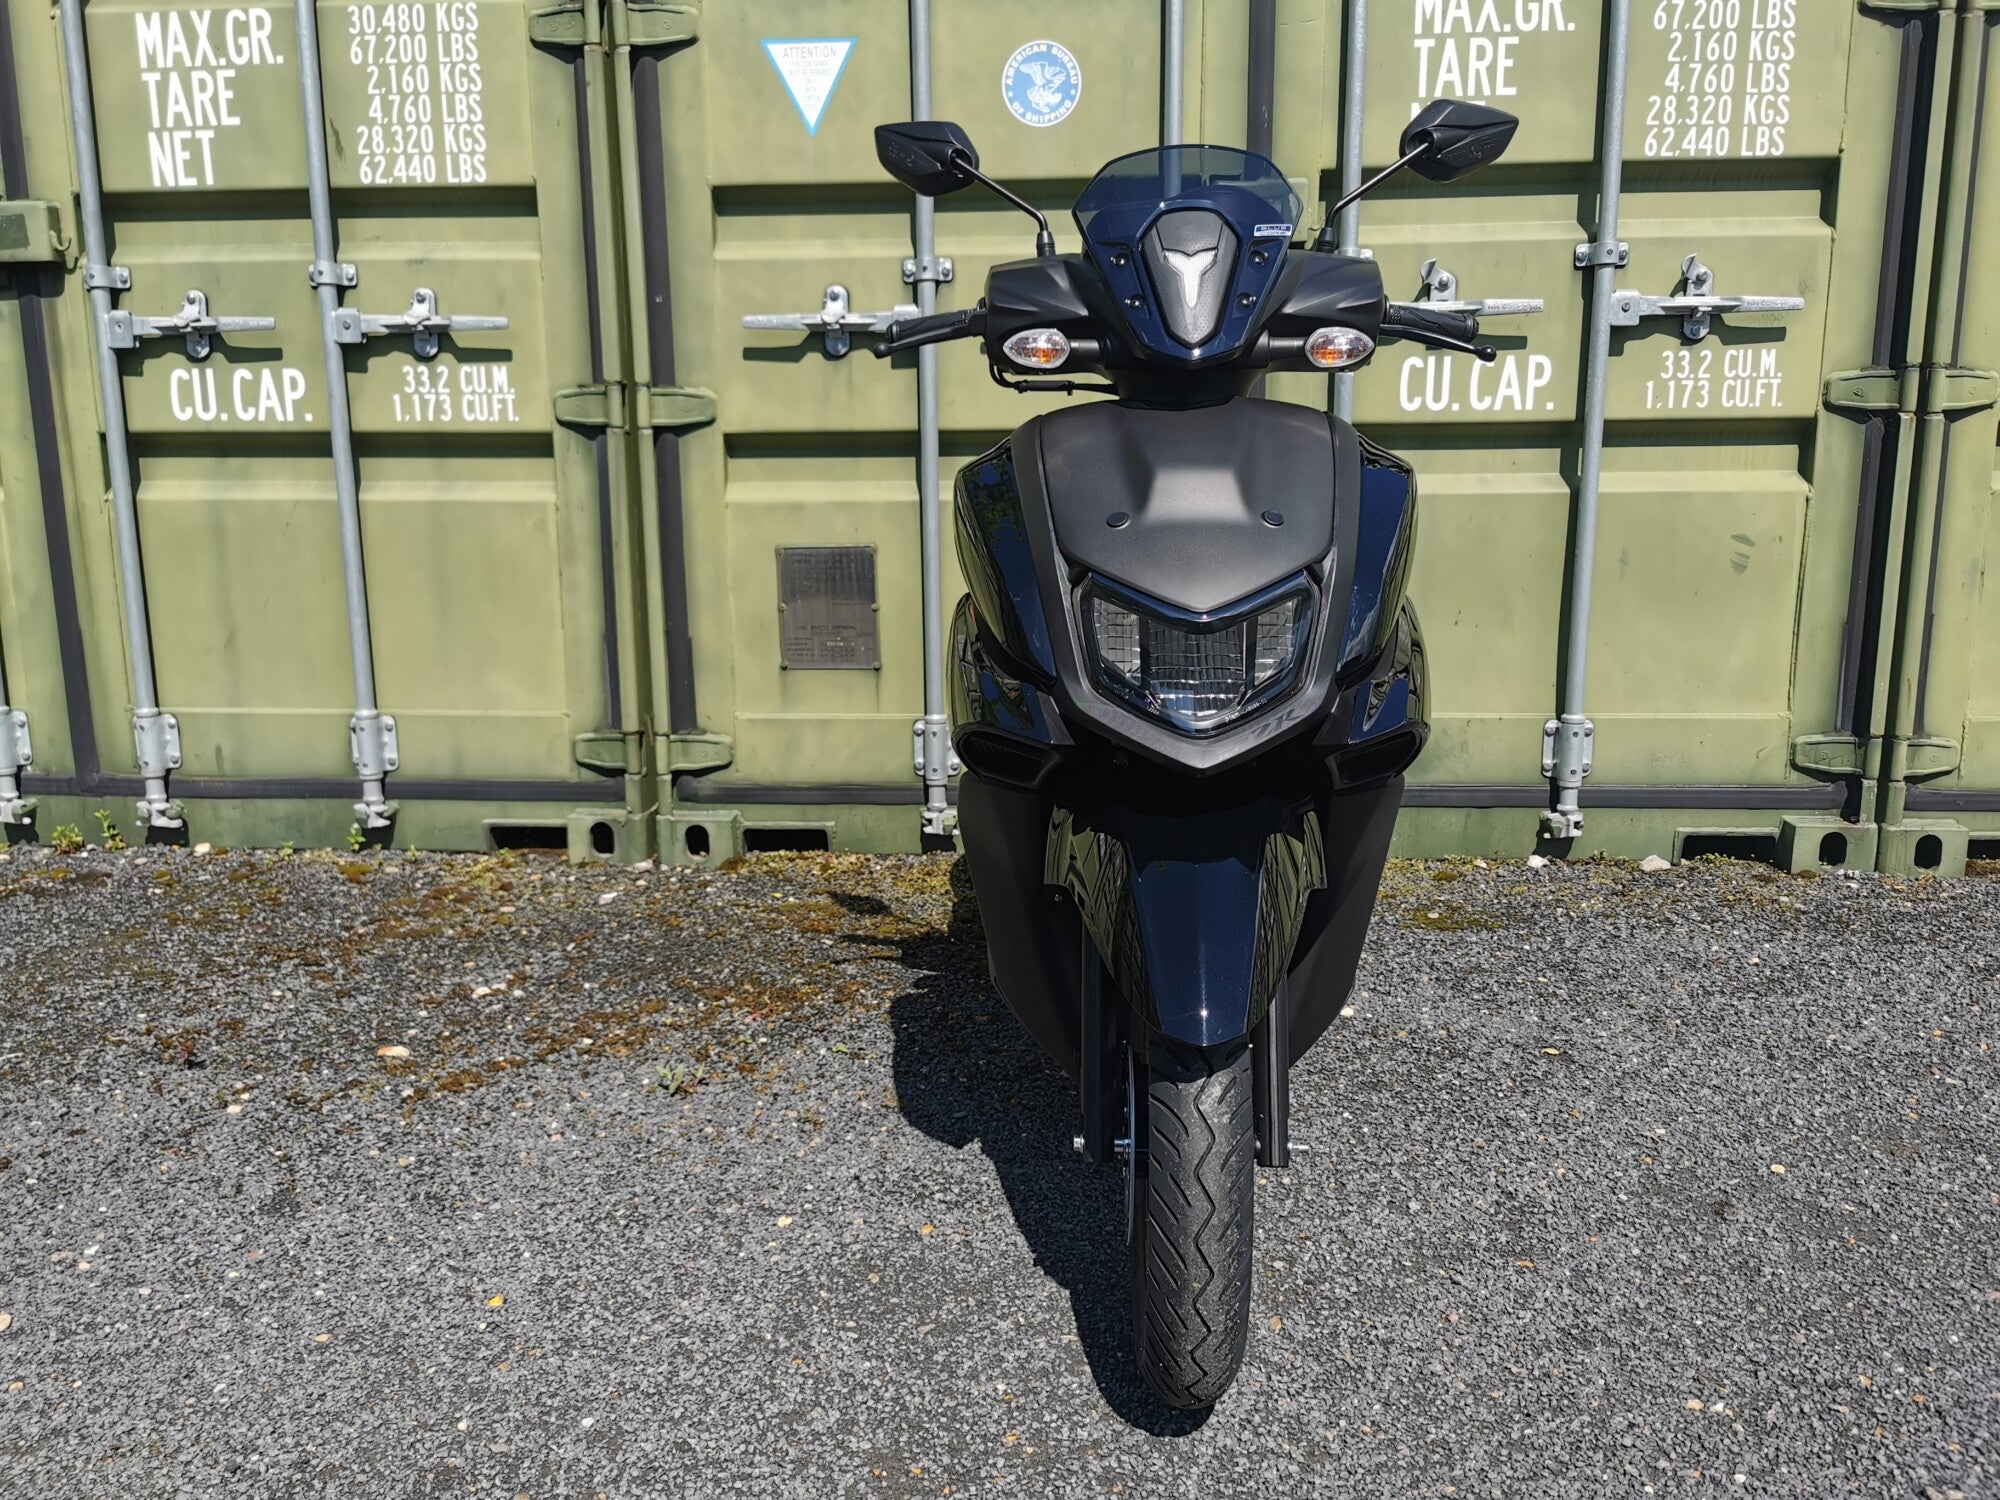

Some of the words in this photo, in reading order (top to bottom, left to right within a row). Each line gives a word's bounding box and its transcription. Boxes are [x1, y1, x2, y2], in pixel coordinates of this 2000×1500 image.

[347, 3, 425, 35] 30,480
[435, 1, 479, 32] KGS
[1653, 0, 1740, 30] 67,200
[1751, 0, 1797, 29] LBS
[135, 7, 284, 69] MAX.GR.
[350, 33, 427, 65] 67,200
[437, 32, 479, 63] LBS
[782, 45, 838, 59] ATTENTION
[1667, 30, 1737, 63] 2,160
[1748, 30, 1796, 61] KGS
[367, 63, 430, 95] 2,160
[439, 62, 483, 93] KGS
[1006, 44, 1048, 86] AMERICAN
[1051, 46, 1079, 85] BUREAU
[1413, 36, 1520, 98] TARE
[1664, 62, 1735, 95] 4,760
[1746, 62, 1791, 94] LBS
[141, 69, 241, 129] TARE
[368, 93, 432, 125] 4,760
[441, 92, 483, 123] LBS
[1012, 101, 1025, 114] OF
[1025, 100, 1073, 123] SHIPPING
[1646, 94, 1732, 126] 28,320
[1743, 94, 1790, 125] KGS
[357, 123, 434, 155] 28,320
[443, 122, 487, 153] KGS
[1644, 126, 1730, 158] 62,440
[1740, 126, 1785, 156] LBS
[148, 129, 215, 187] NET
[359, 153, 436, 184] 62,440
[446, 153, 487, 183] LBS
[402, 365, 450, 394] 33.2
[459, 365, 515, 394] CU.M.
[1660, 349, 1712, 379] 33.2
[1723, 348, 1782, 378] CU.M.
[393, 393, 452, 422] 1,173
[462, 393, 519, 422] CU.FT.
[1646, 379, 1710, 409] 1,173
[1721, 378, 1782, 408] CU.FT.
